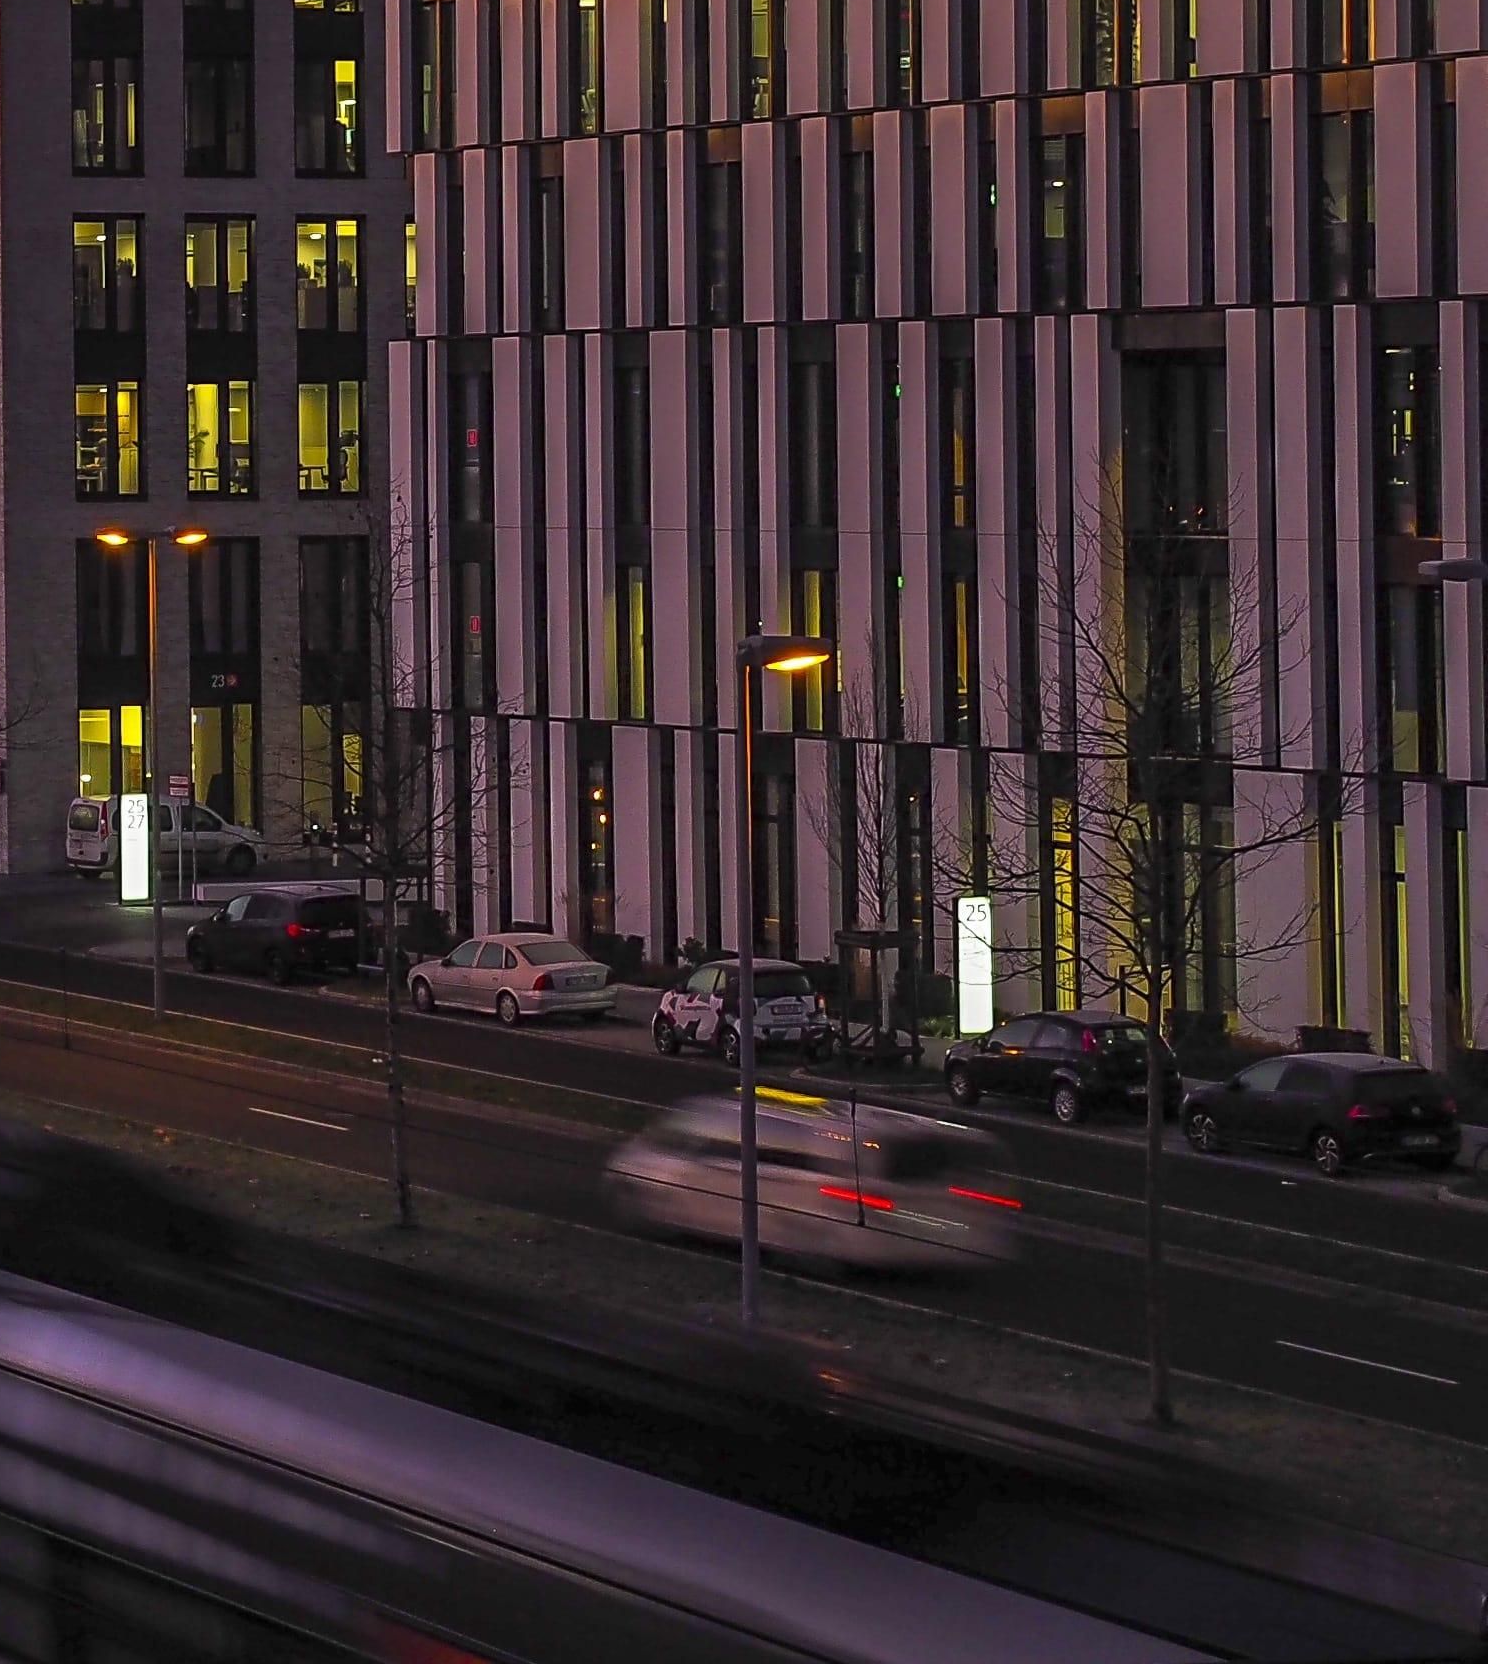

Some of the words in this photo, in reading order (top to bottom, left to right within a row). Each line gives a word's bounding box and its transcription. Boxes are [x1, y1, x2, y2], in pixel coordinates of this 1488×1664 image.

[211, 674, 225, 687] 23
[128, 799, 145, 814] 25
[128, 815, 145, 829] 27
[966, 903, 987, 922] 25
